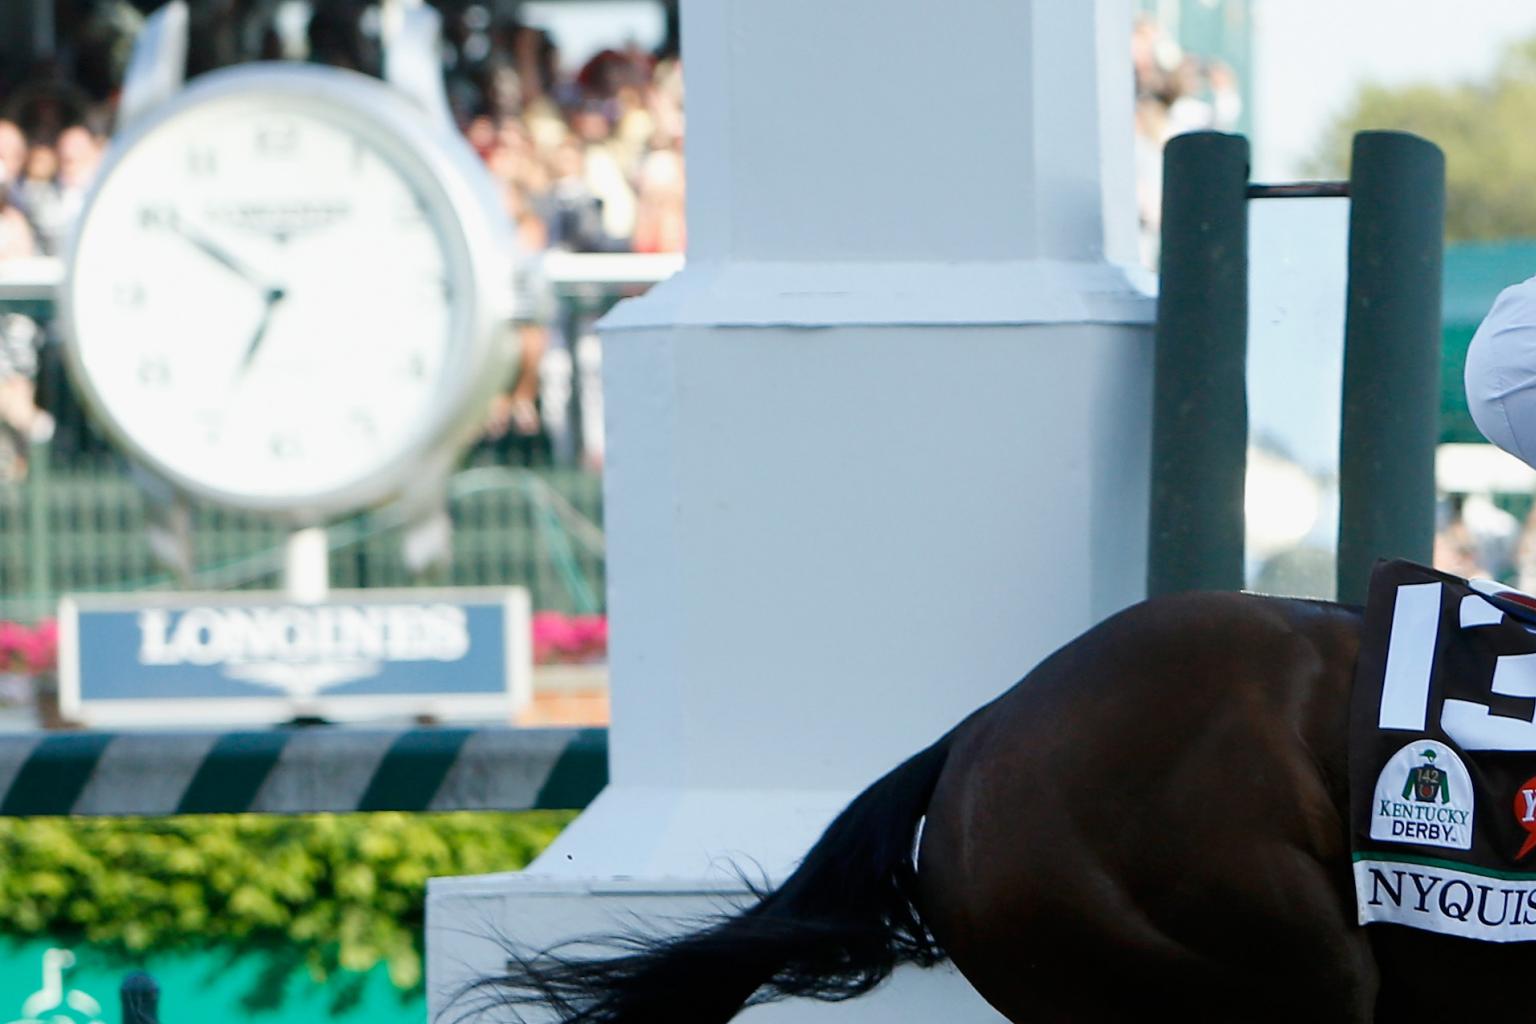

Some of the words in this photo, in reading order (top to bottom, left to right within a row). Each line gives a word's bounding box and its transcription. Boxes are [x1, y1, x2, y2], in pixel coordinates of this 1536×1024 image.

[140, 606, 469, 665] LONGINES
[1379, 800, 1470, 825] KENTUCKY
[1392, 820, 1453, 841] DERBY
